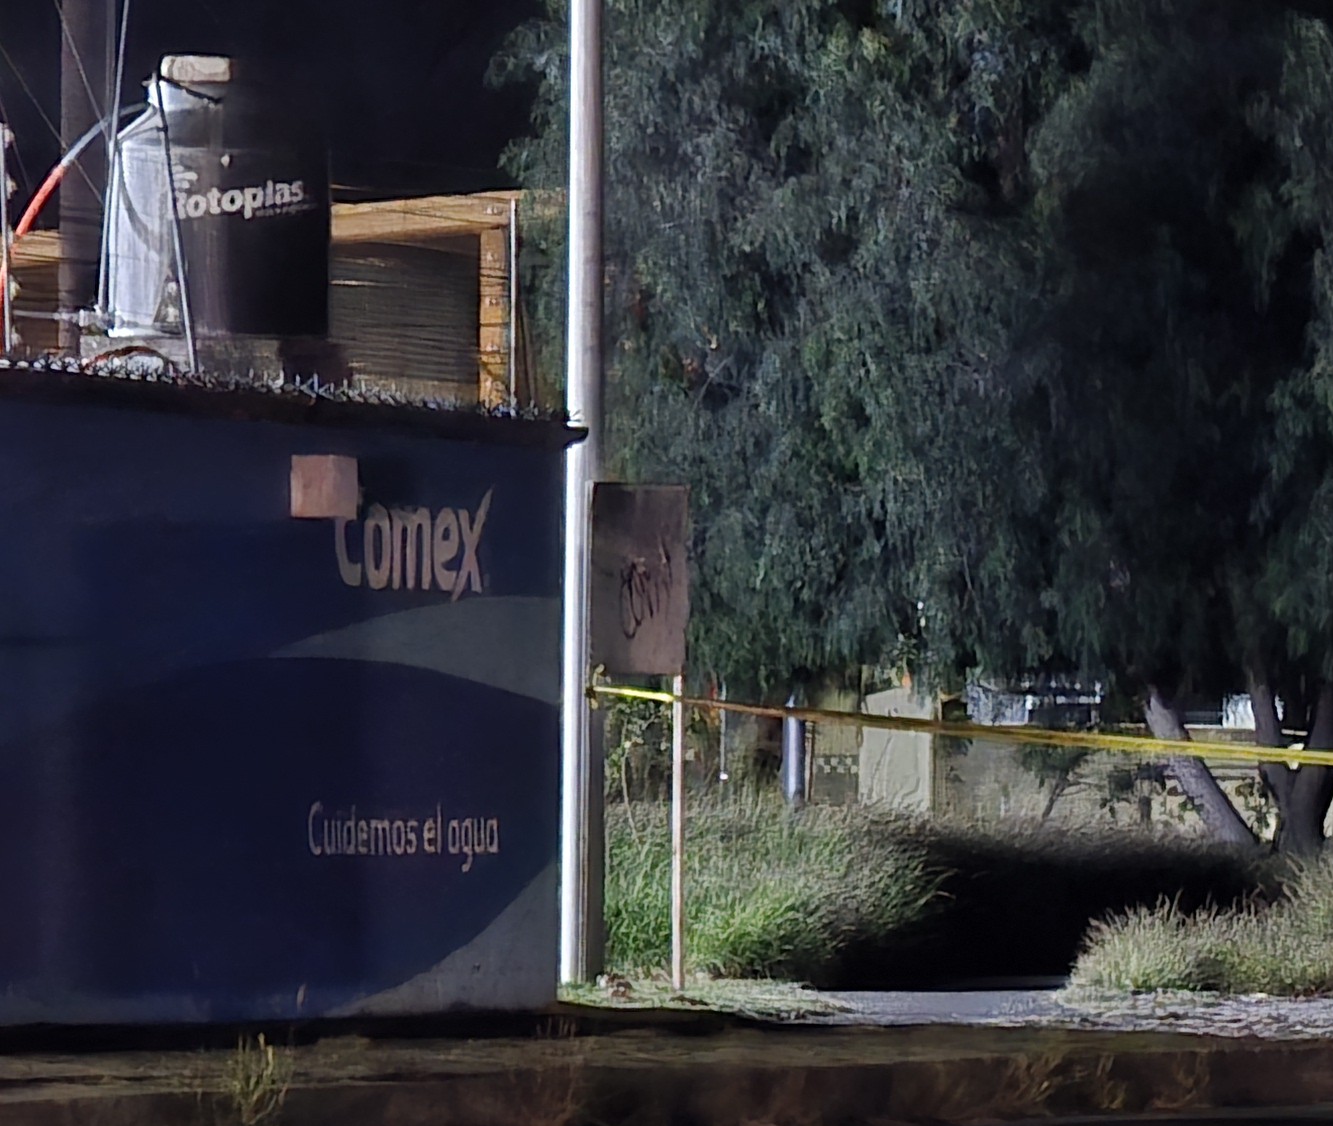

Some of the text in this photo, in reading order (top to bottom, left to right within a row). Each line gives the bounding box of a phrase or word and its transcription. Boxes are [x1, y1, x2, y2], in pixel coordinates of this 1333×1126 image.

[335, 485, 494, 601] Comex
[308, 801, 499, 872] Cuidemos el agua
